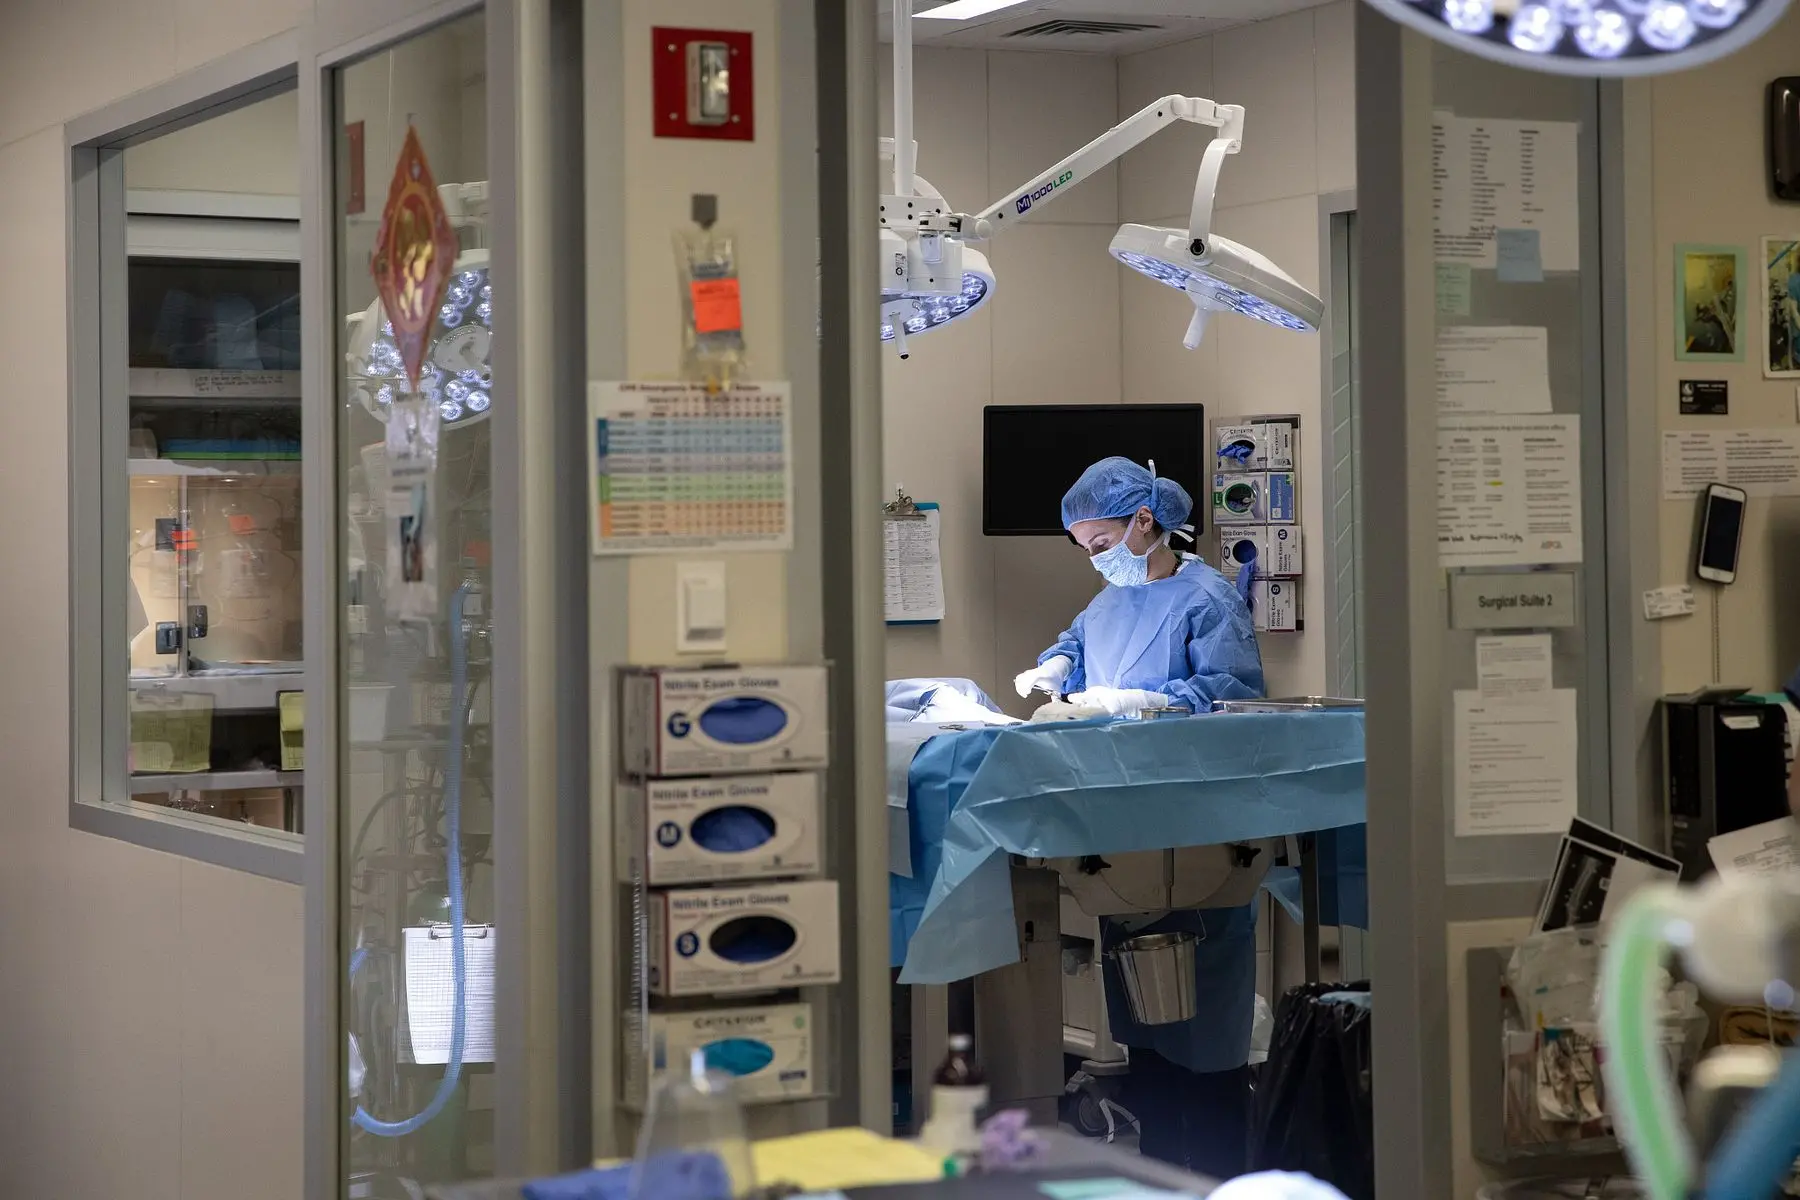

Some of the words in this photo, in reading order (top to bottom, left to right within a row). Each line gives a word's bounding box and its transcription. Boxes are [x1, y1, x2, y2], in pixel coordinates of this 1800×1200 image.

[1478, 595, 1517, 610] Surgical
[1520, 594, 1545, 607] Suite
[1547, 594, 1553, 606] 2
[664, 680, 699, 690] Nitrile
[703, 678, 735, 689] Exam
[739, 678, 779, 688] Gloves
[653, 789, 688, 799] Nitrile
[692, 787, 723, 797] Exam
[729, 785, 768, 796] Gloves
[673, 898, 708, 909] Nitrile
[711, 896, 743, 906] Exam
[749, 894, 790, 904] Gloves
